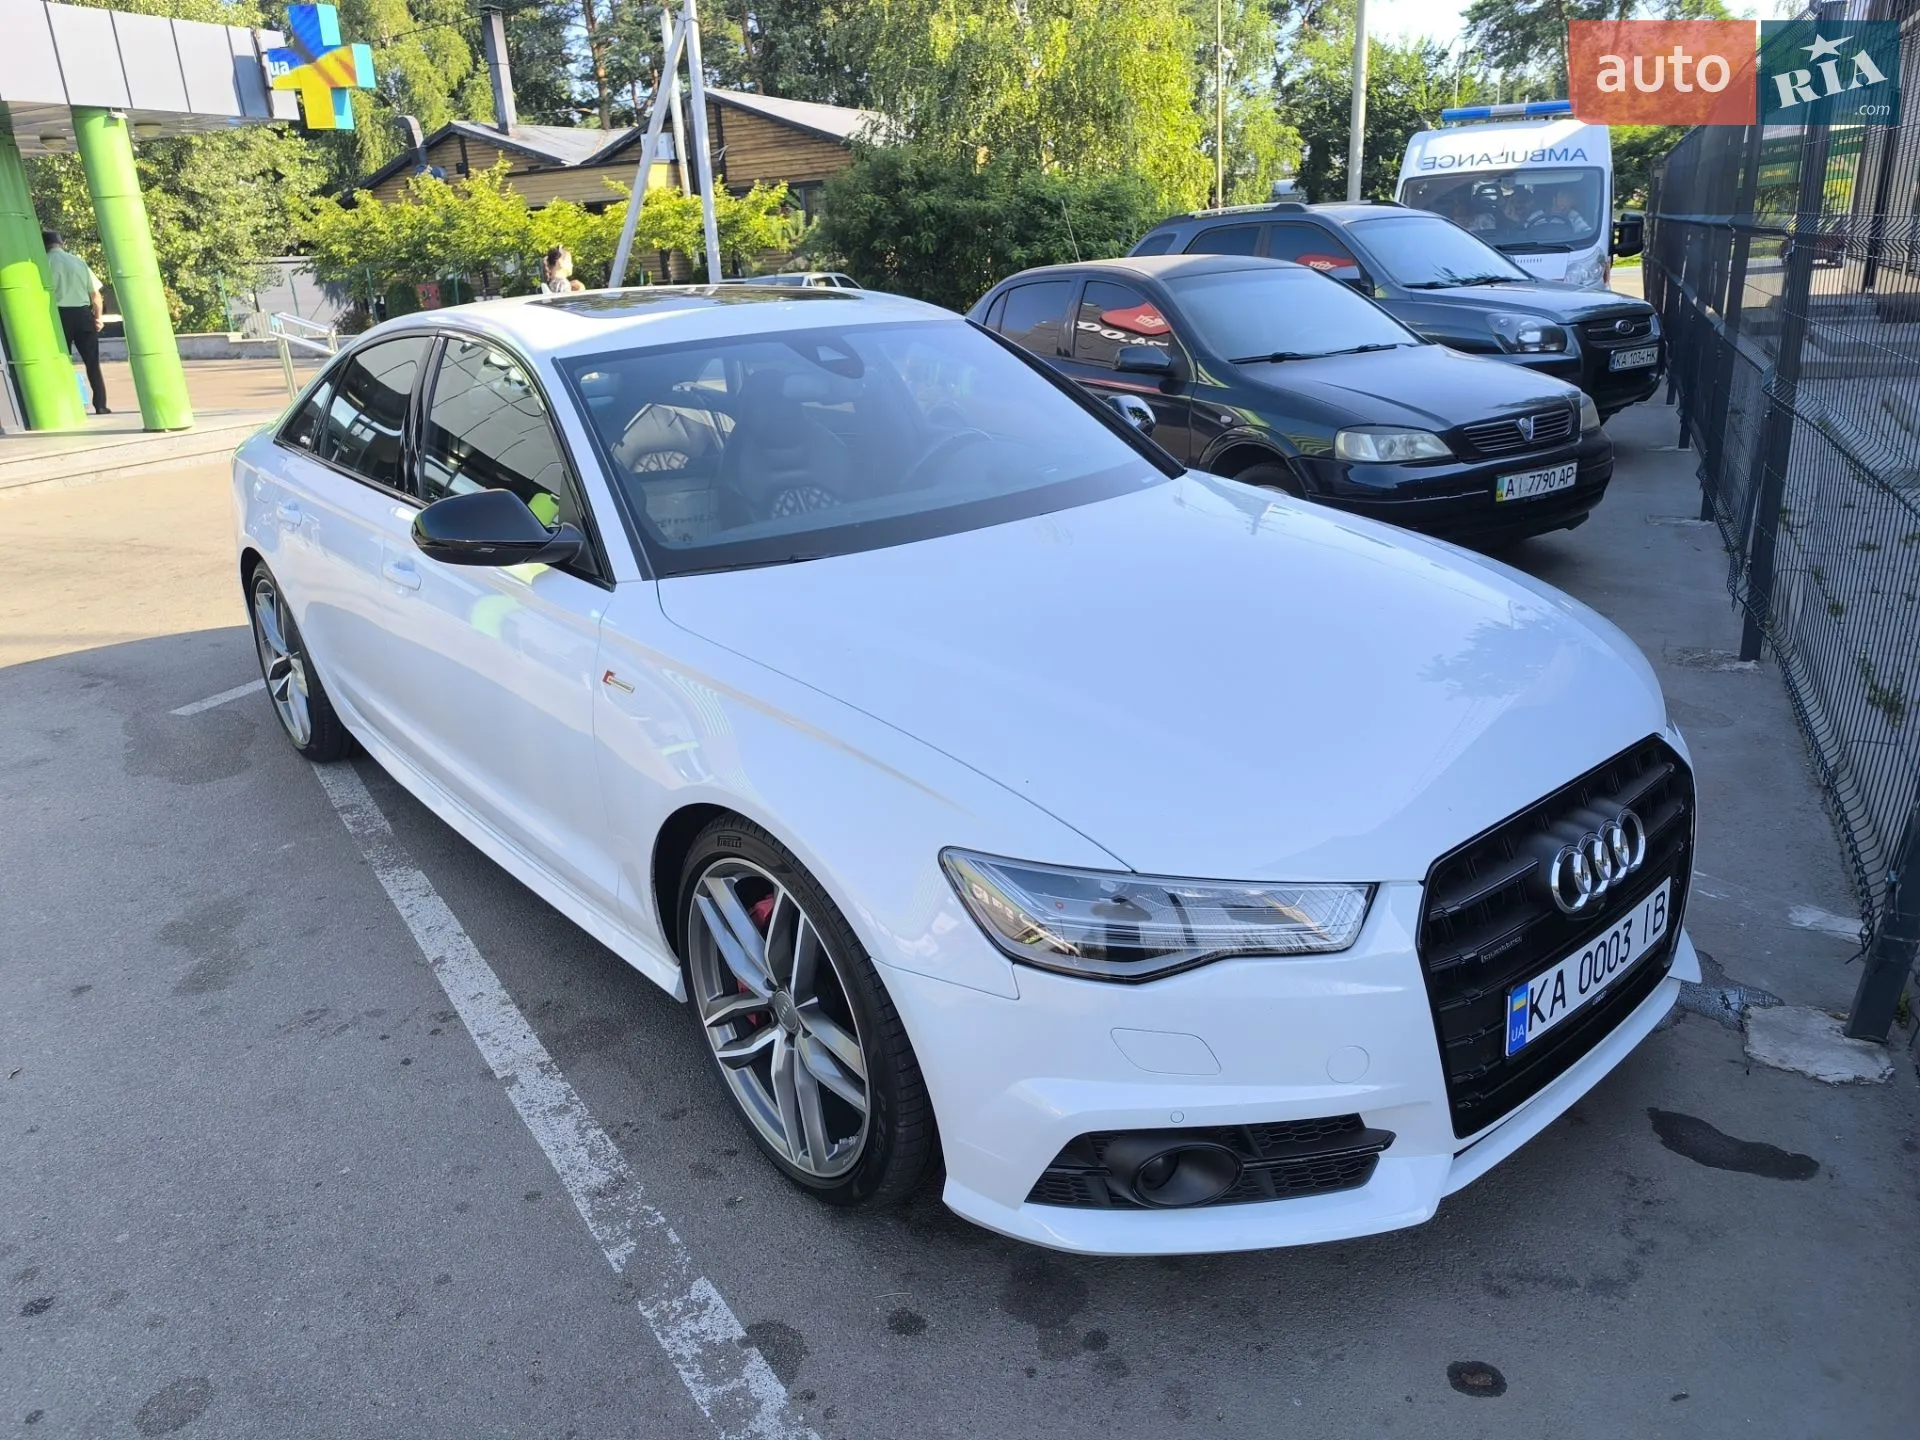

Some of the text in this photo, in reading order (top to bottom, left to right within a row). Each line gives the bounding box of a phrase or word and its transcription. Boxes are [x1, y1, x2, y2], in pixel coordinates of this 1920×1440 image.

[1615, 353, 1627, 368] KA
[1630, 351, 1645, 366] 1034
[1528, 471, 1556, 493] 7790
[1558, 466, 1575, 487] AP
[1528, 890, 1666, 1033] KA 0003 IB
[1511, 1023, 1525, 1043] UA
